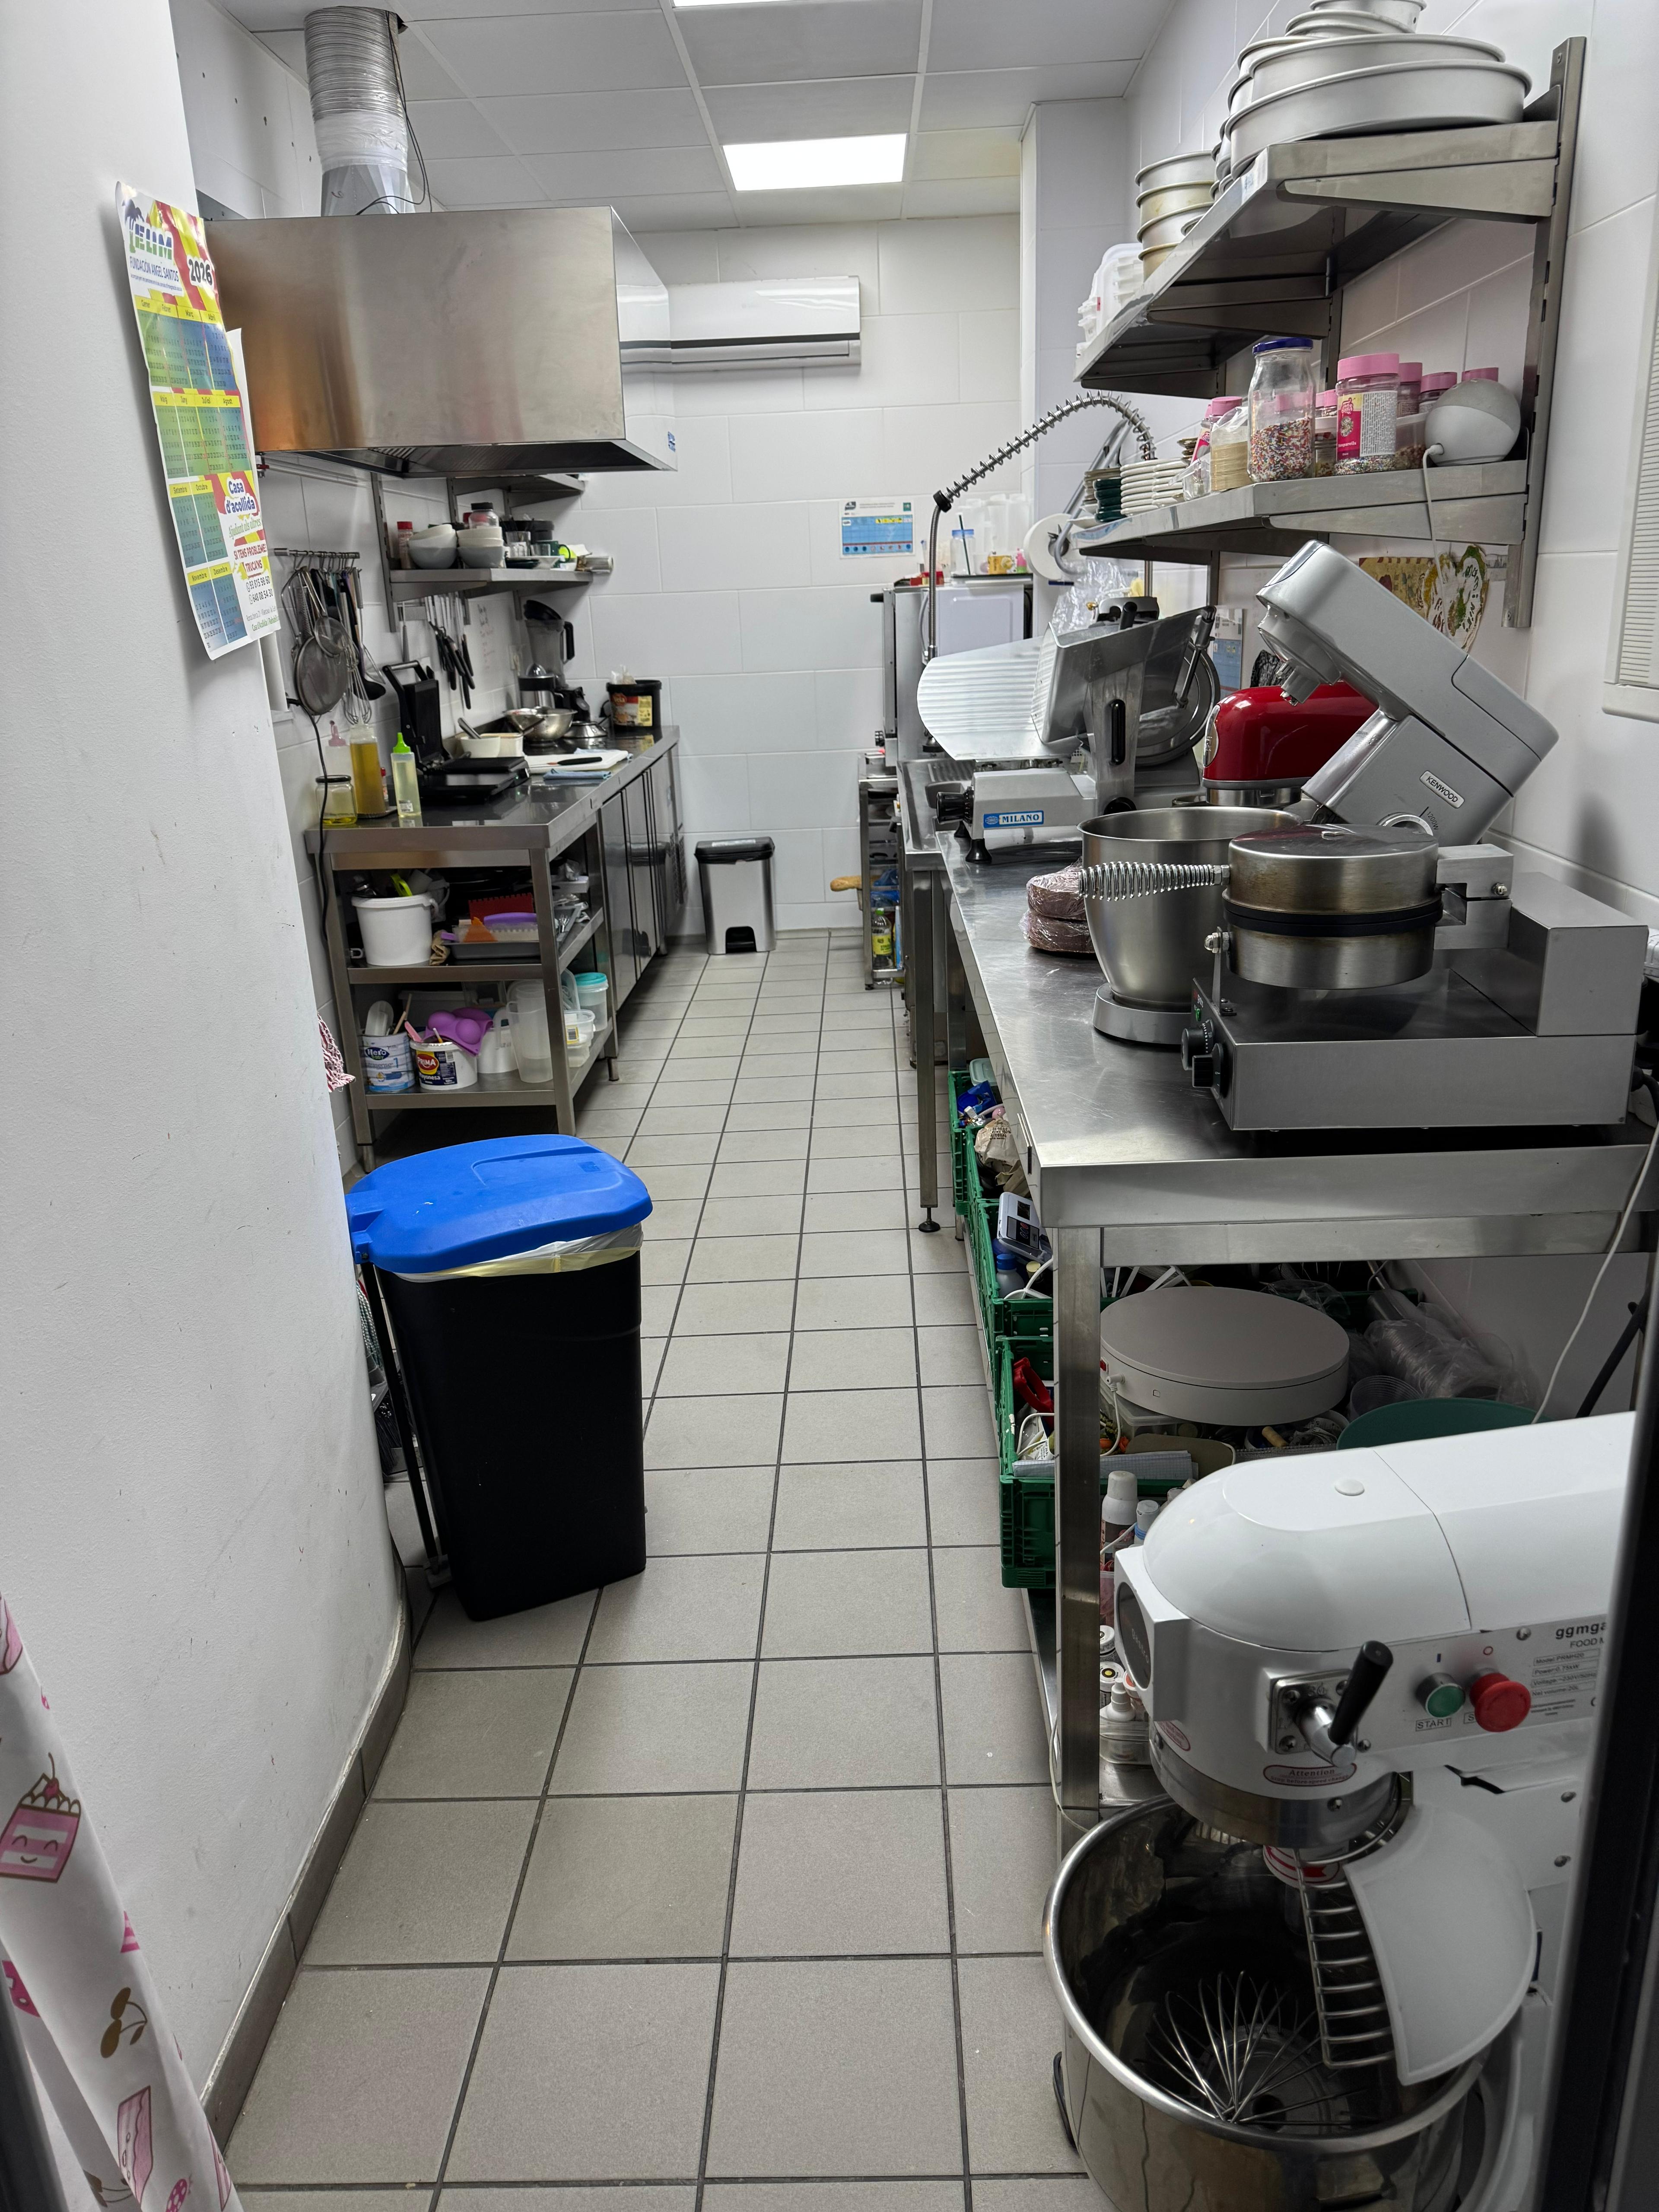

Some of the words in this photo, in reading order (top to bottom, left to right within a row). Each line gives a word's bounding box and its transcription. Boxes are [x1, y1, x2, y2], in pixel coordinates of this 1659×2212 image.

[130, 256, 151, 274] FUNDACIÓN
[152, 263, 162, 279] ANGEL
[163, 265, 179, 282] SANTOS
[188, 259, 213, 286] 2026
[223, 397, 233, 406] Agost
[229, 480, 244, 494] Casa
[226, 496, 255, 514] d'acollida
[238, 548, 247, 558] TENS
[192, 573, 207, 582] Novembre
[213, 566, 228, 575] Desembre
[1426, 776, 1458, 803] KENWOOD
[1002, 814, 1039, 823] MILANO
[1427, 811, 1439, 831] 1200W
[417, 1057, 436, 1066] PRIMA
[1131, 1628, 1149, 1664] gastro
[1570, 1638, 1598, 1648] FOOD
[1417, 1718, 1451, 1729] START
